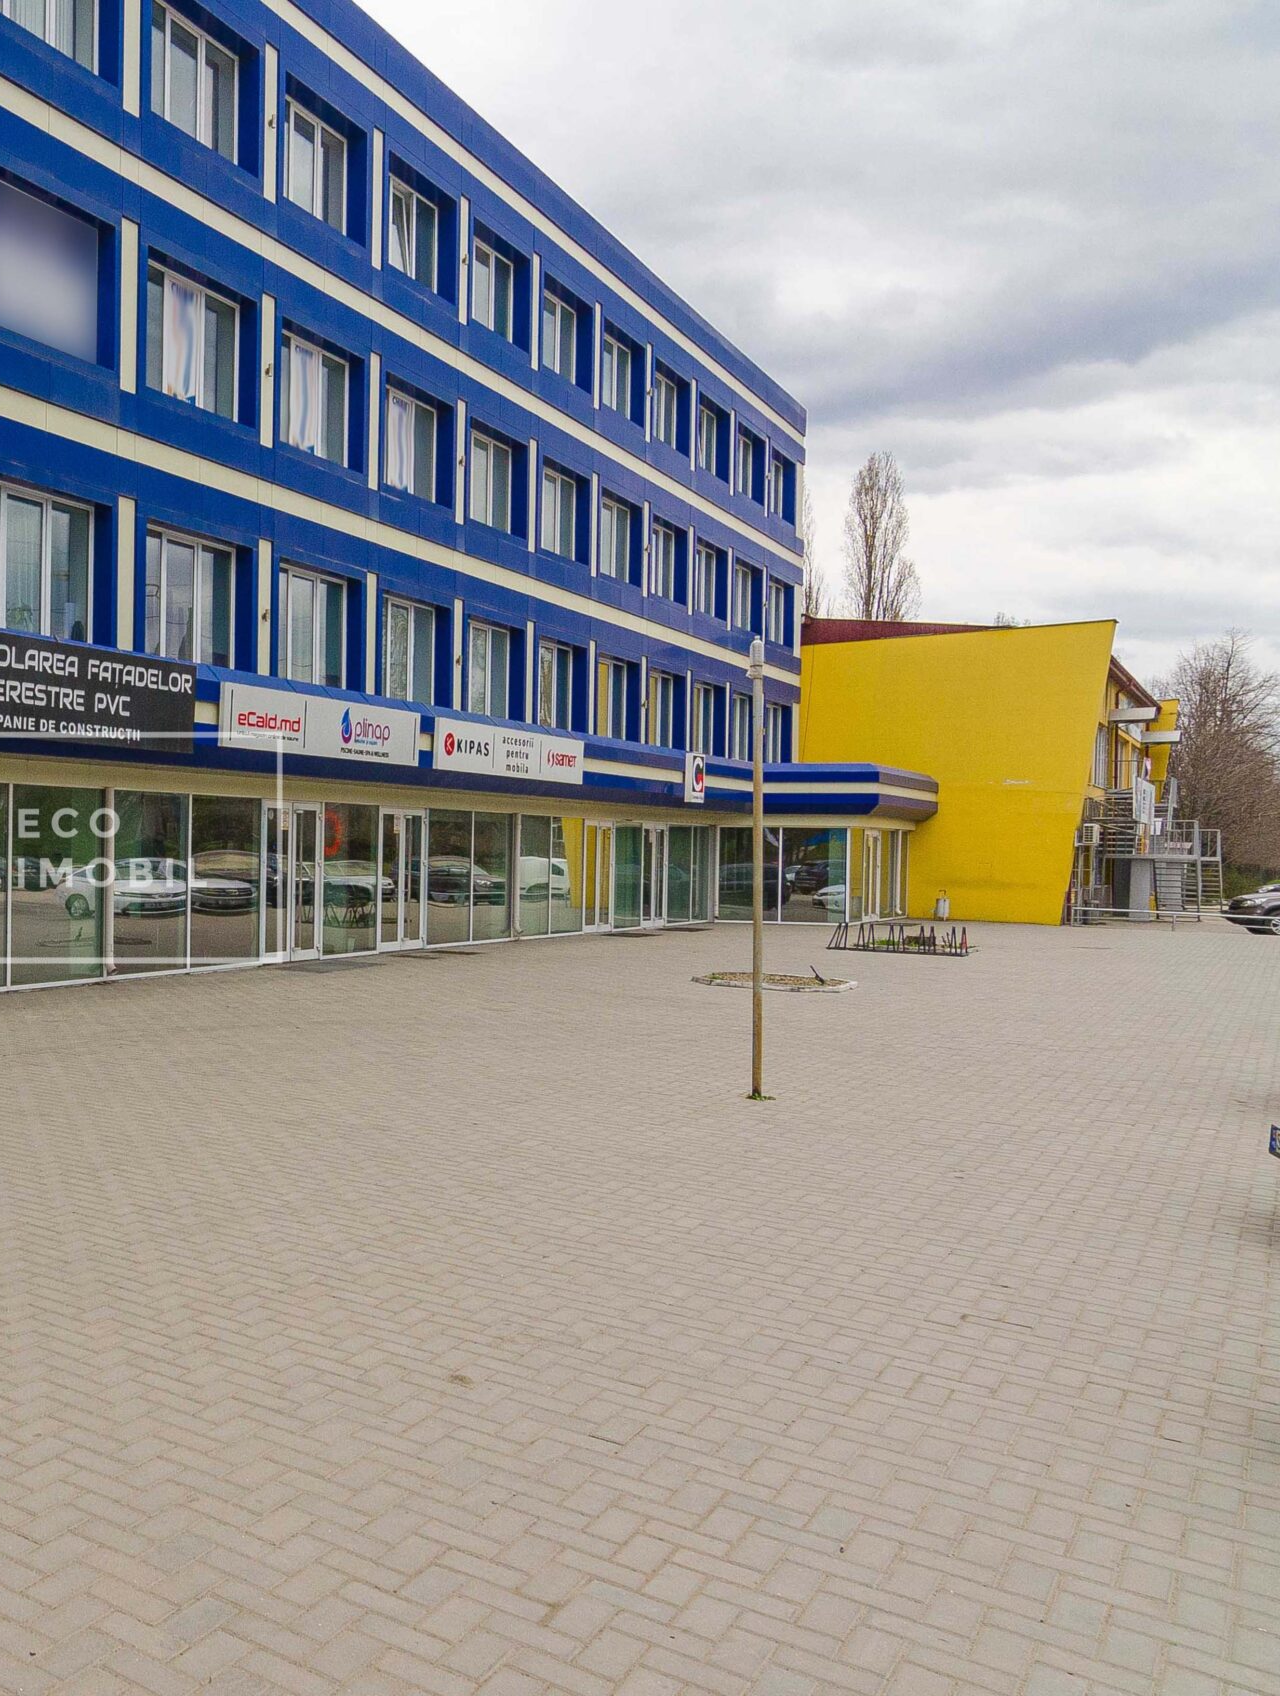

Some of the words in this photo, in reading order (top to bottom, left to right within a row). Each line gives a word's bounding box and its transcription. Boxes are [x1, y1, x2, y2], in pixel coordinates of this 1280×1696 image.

[94, 692, 131, 717] PVC
[39, 719, 56, 733] DE
[237, 711, 301, 733] eCald.md
[456, 738, 490, 757] KIPAS
[502, 735, 534, 749] accesorii
[506, 749, 529, 761] pentru
[505, 763, 529, 774] mobila
